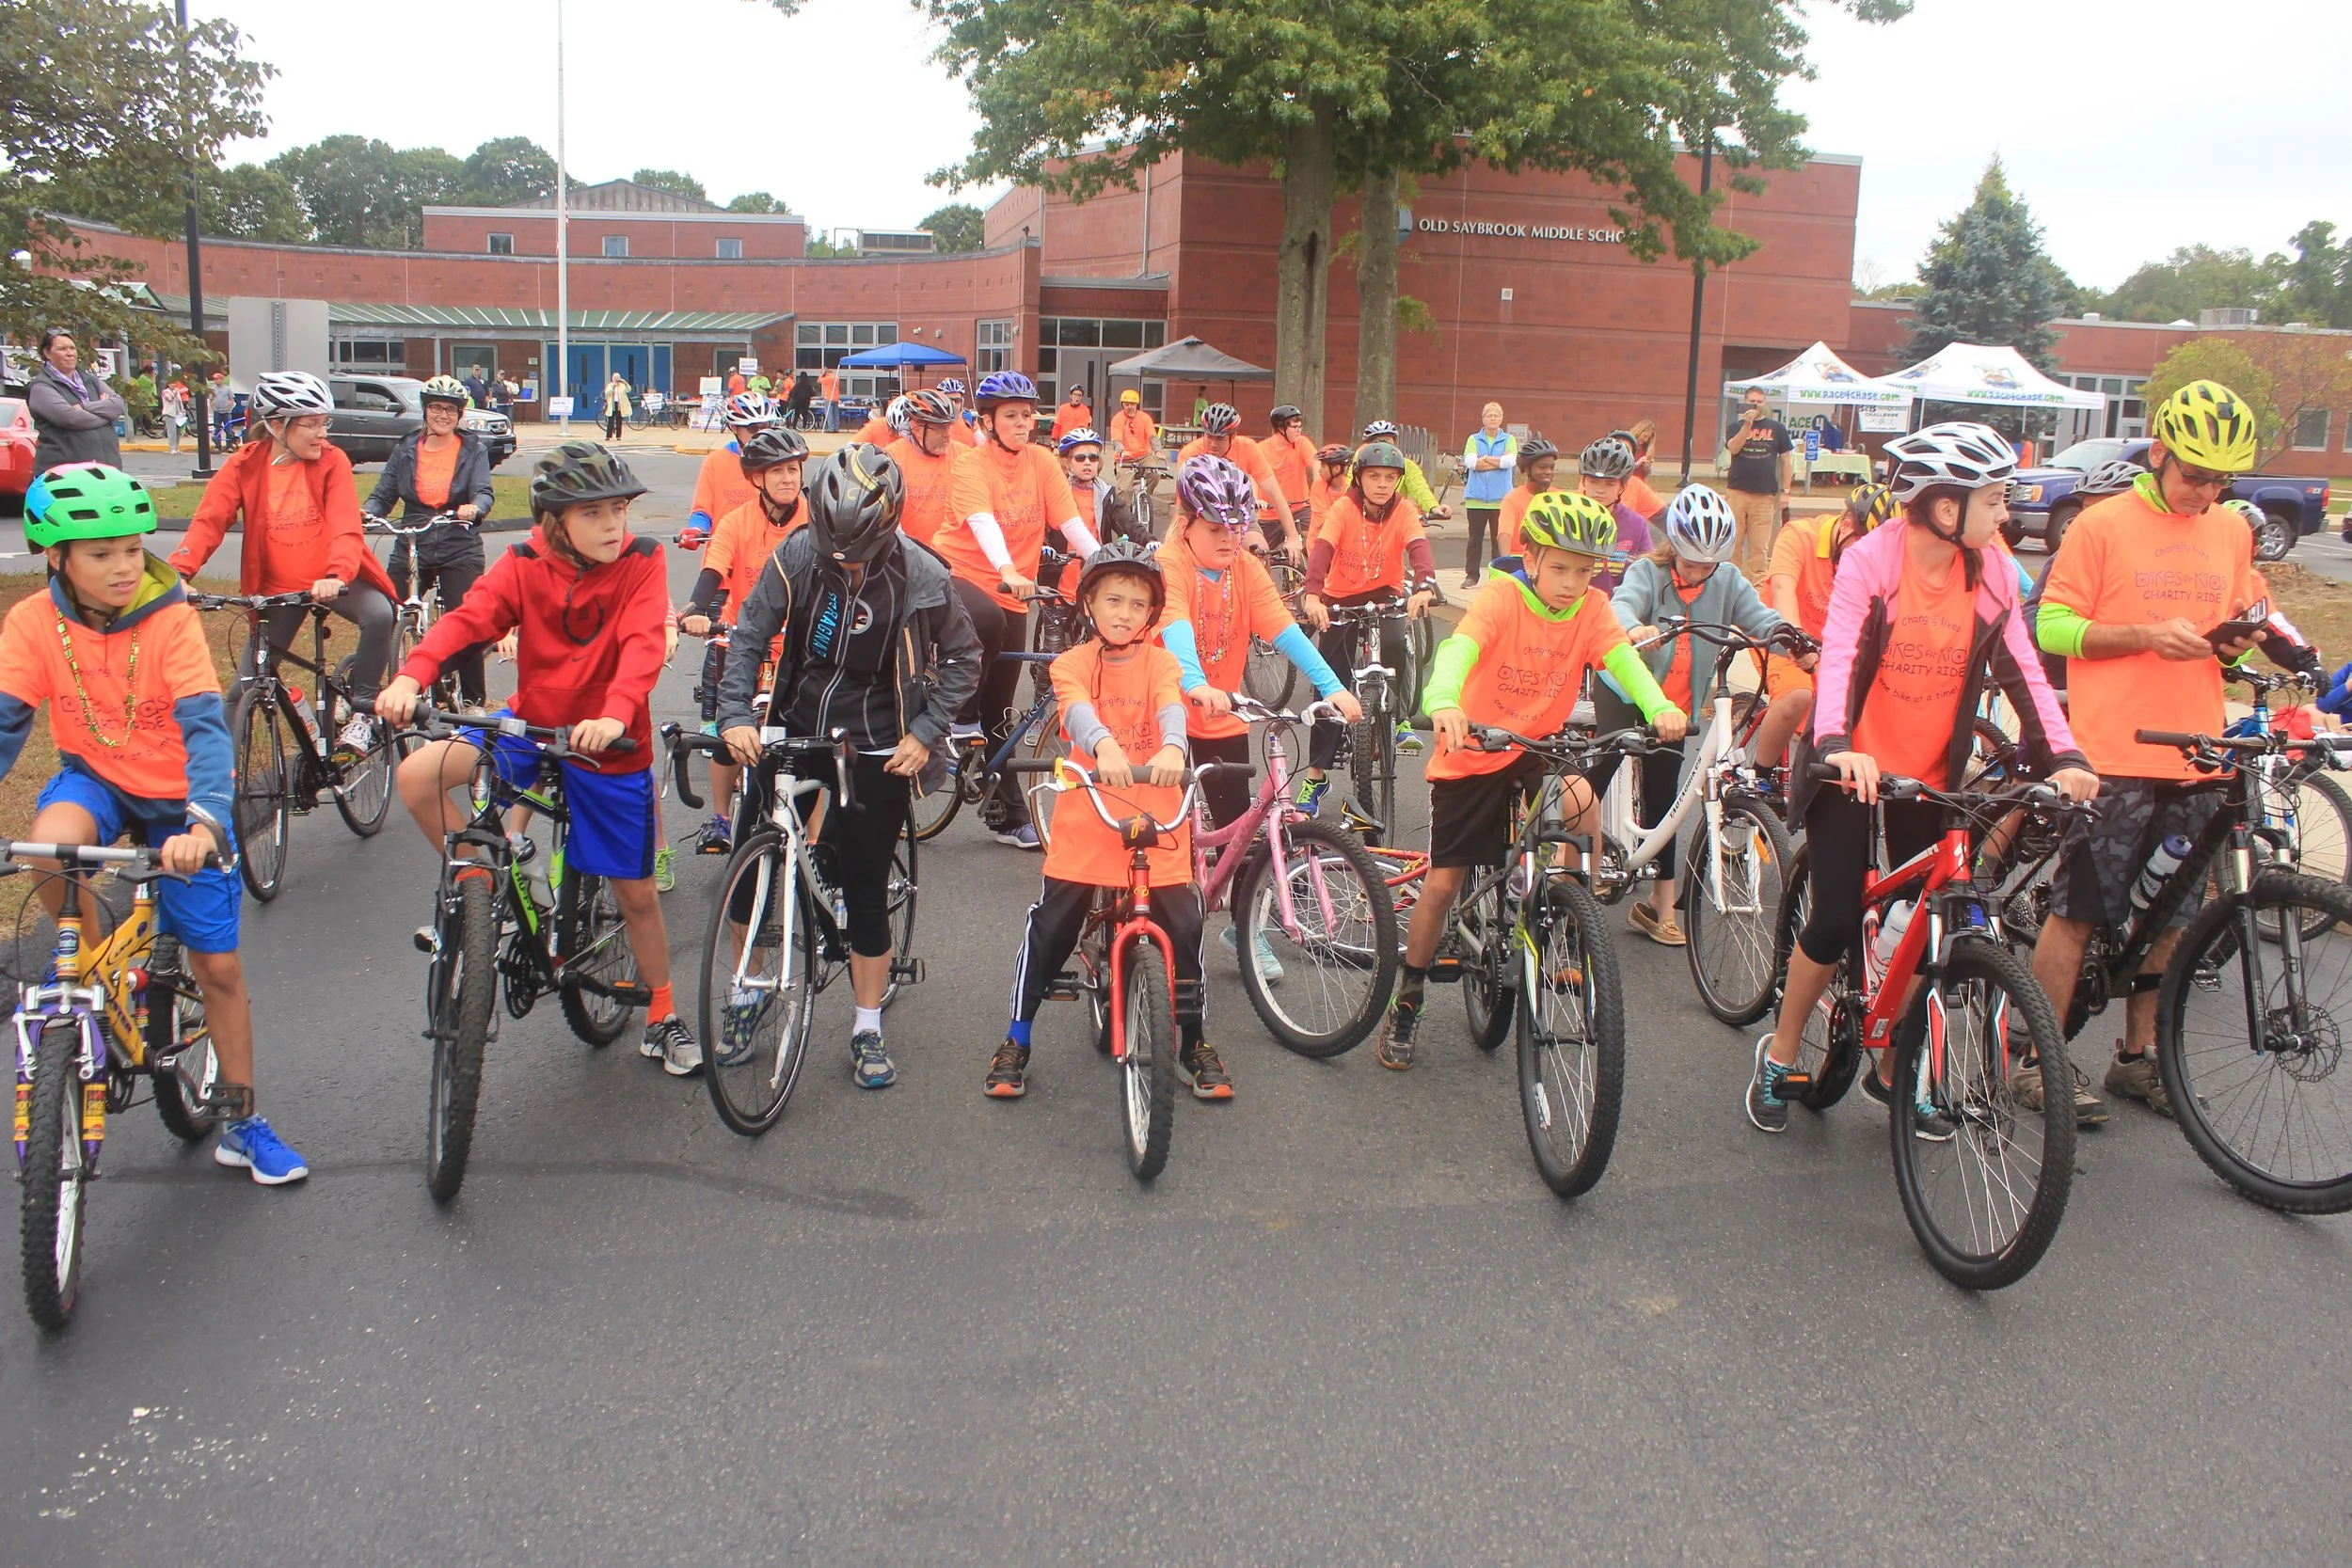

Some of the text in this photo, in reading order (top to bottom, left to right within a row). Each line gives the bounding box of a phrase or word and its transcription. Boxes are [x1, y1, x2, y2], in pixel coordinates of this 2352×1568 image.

[1419, 218, 1634, 244] OLD SAYBROOK MIDDLE SCHO
[2143, 590, 2223, 604] CHARITY RIDE
[1936, 666, 1966, 678] RIDE
[1892, 688, 1911, 702] bike
